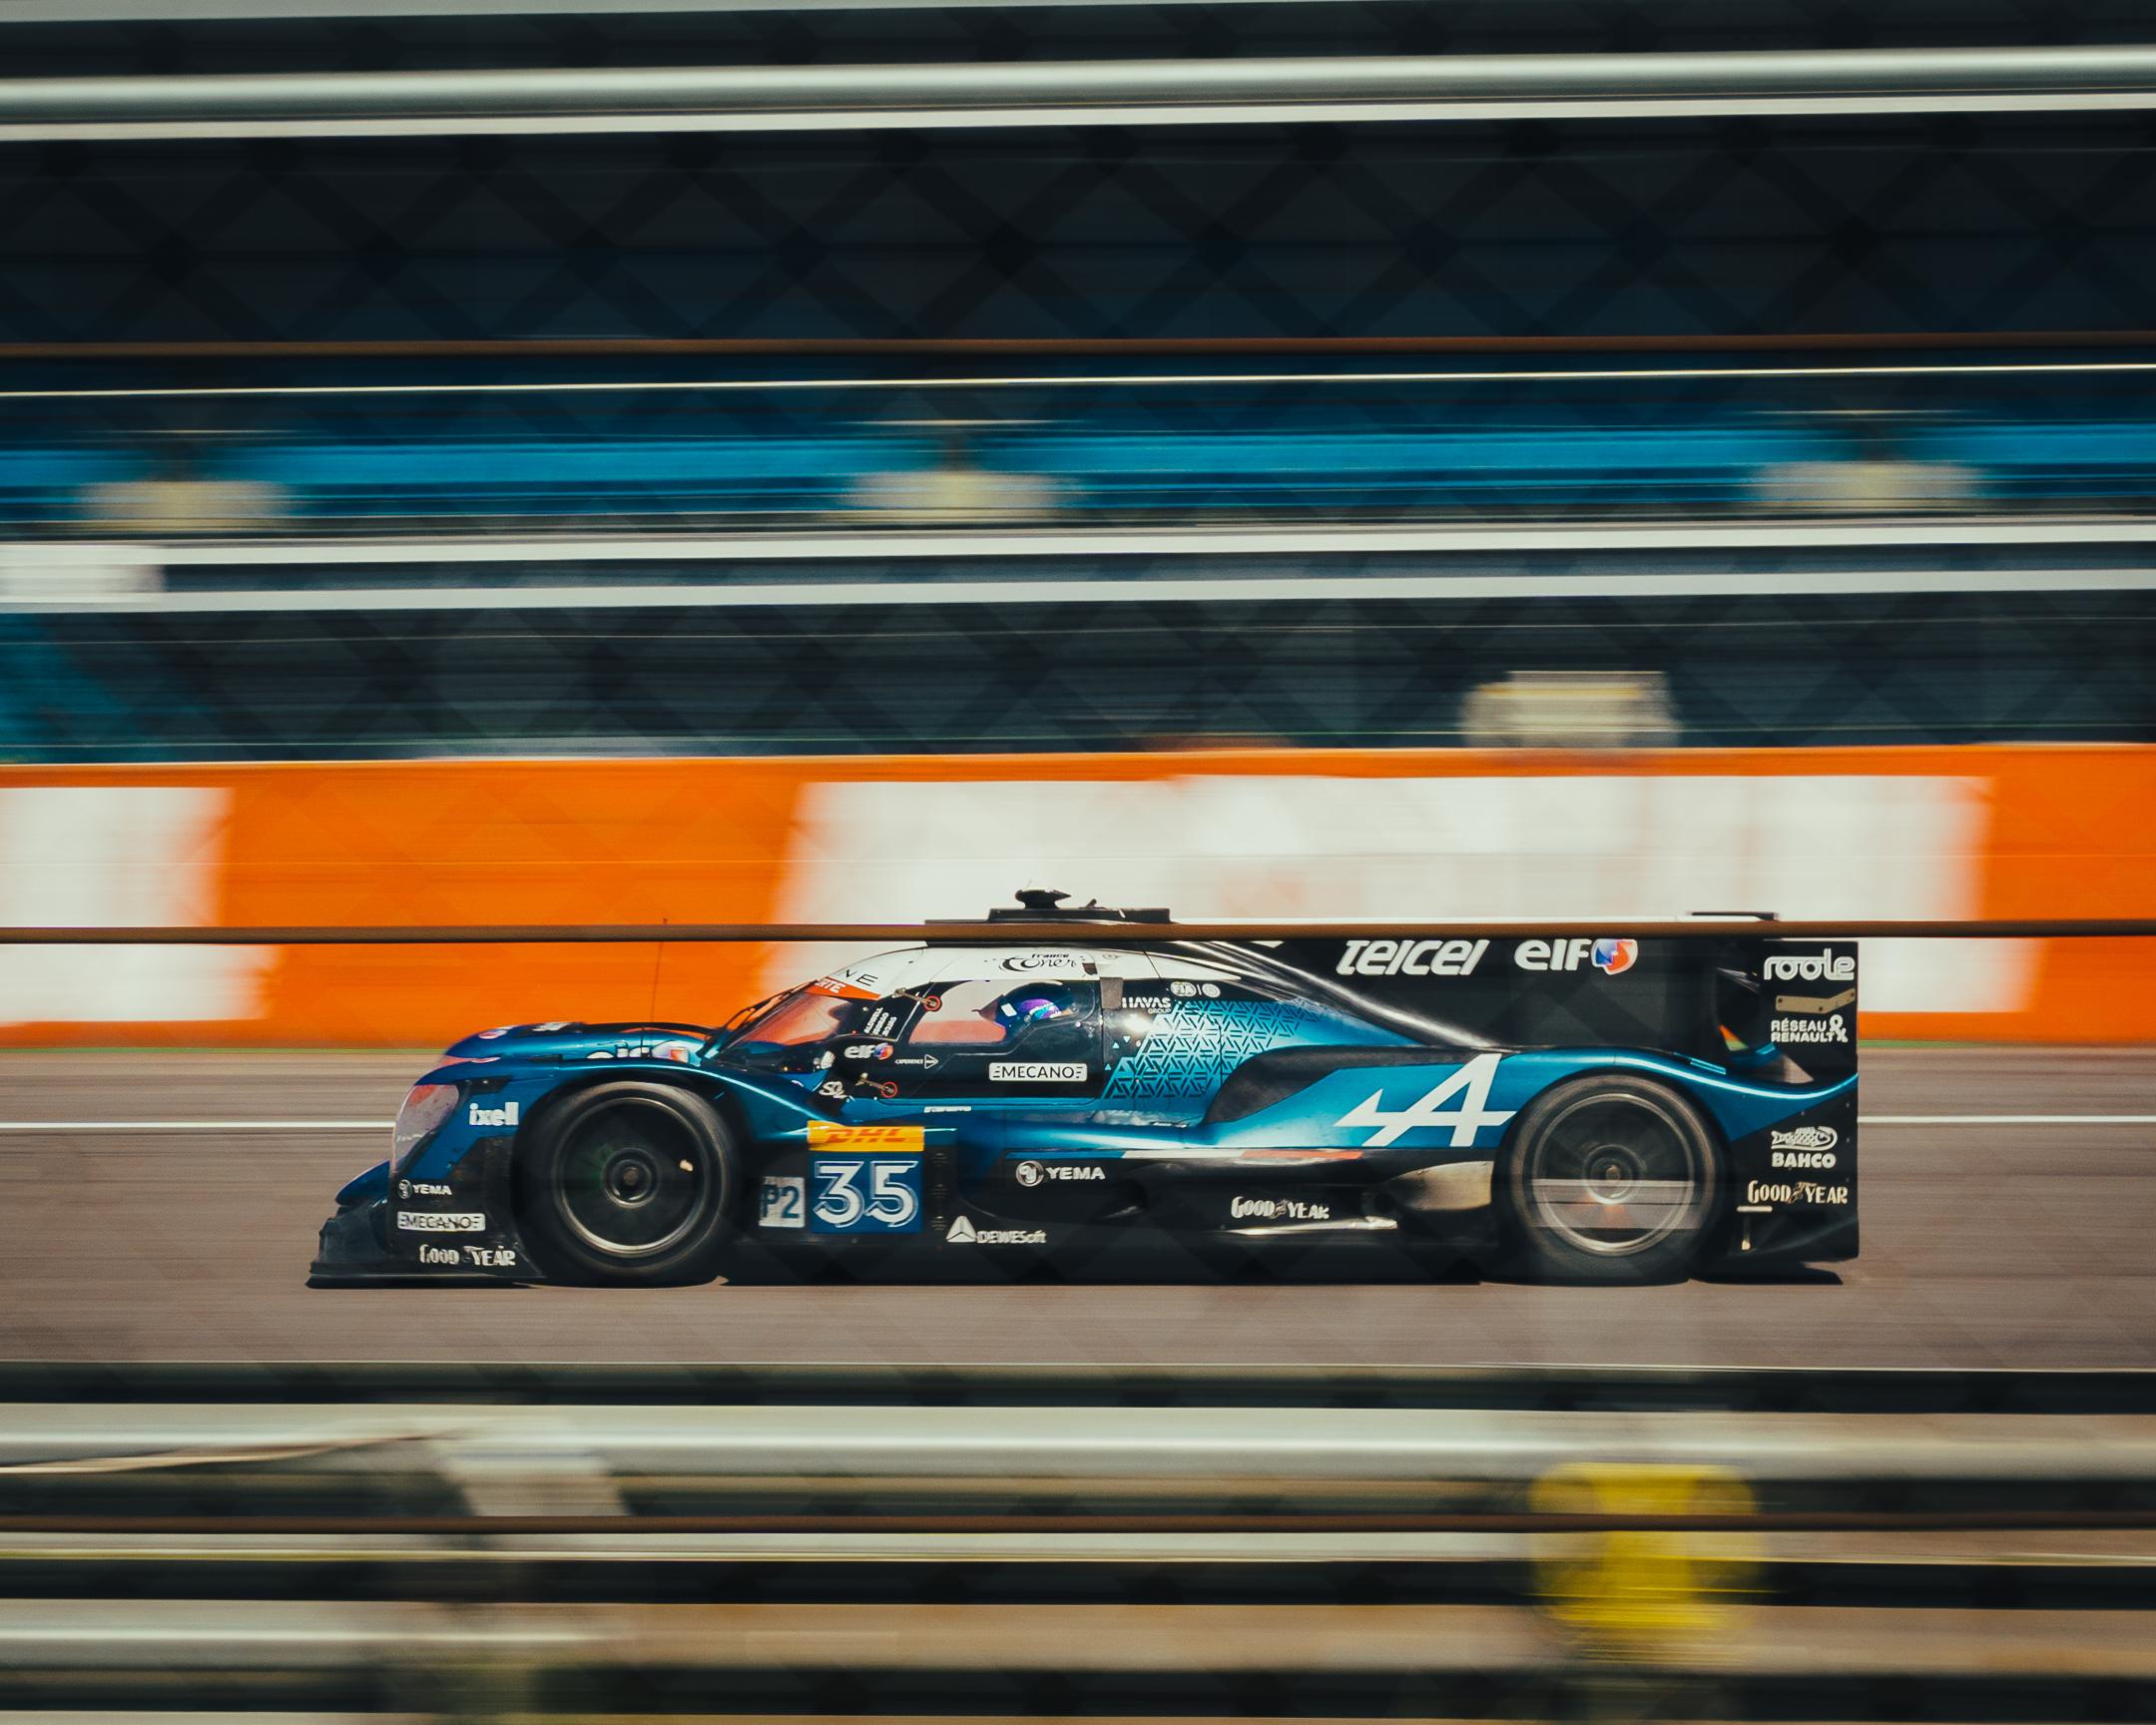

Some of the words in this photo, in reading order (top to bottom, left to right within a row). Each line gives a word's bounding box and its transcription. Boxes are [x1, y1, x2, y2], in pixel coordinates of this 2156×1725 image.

[1336, 938, 1491, 975] telcel
[1513, 938, 1593, 970] elf
[1763, 947, 1856, 980] roole
[1121, 996, 1172, 1008] HAVAS
[1771, 1017, 1827, 1031] RÉSEAU
[1771, 1032, 1836, 1042] RENAULT
[843, 1045, 875, 1059] elf
[469, 1101, 519, 1126] ixell
[825, 1128, 906, 1143] DHL
[1772, 1152, 1837, 1168] BAHCO
[1046, 1167, 1106, 1180] YEMA
[413, 1184, 452, 1195] YEMA
[812, 1160, 919, 1229] 35
[1748, 1180, 1792, 1204] GOOD
[1805, 1186, 1848, 1204] YEAR
[1231, 1196, 1275, 1218] GOOD
[472, 1249, 517, 1266] YEAR
